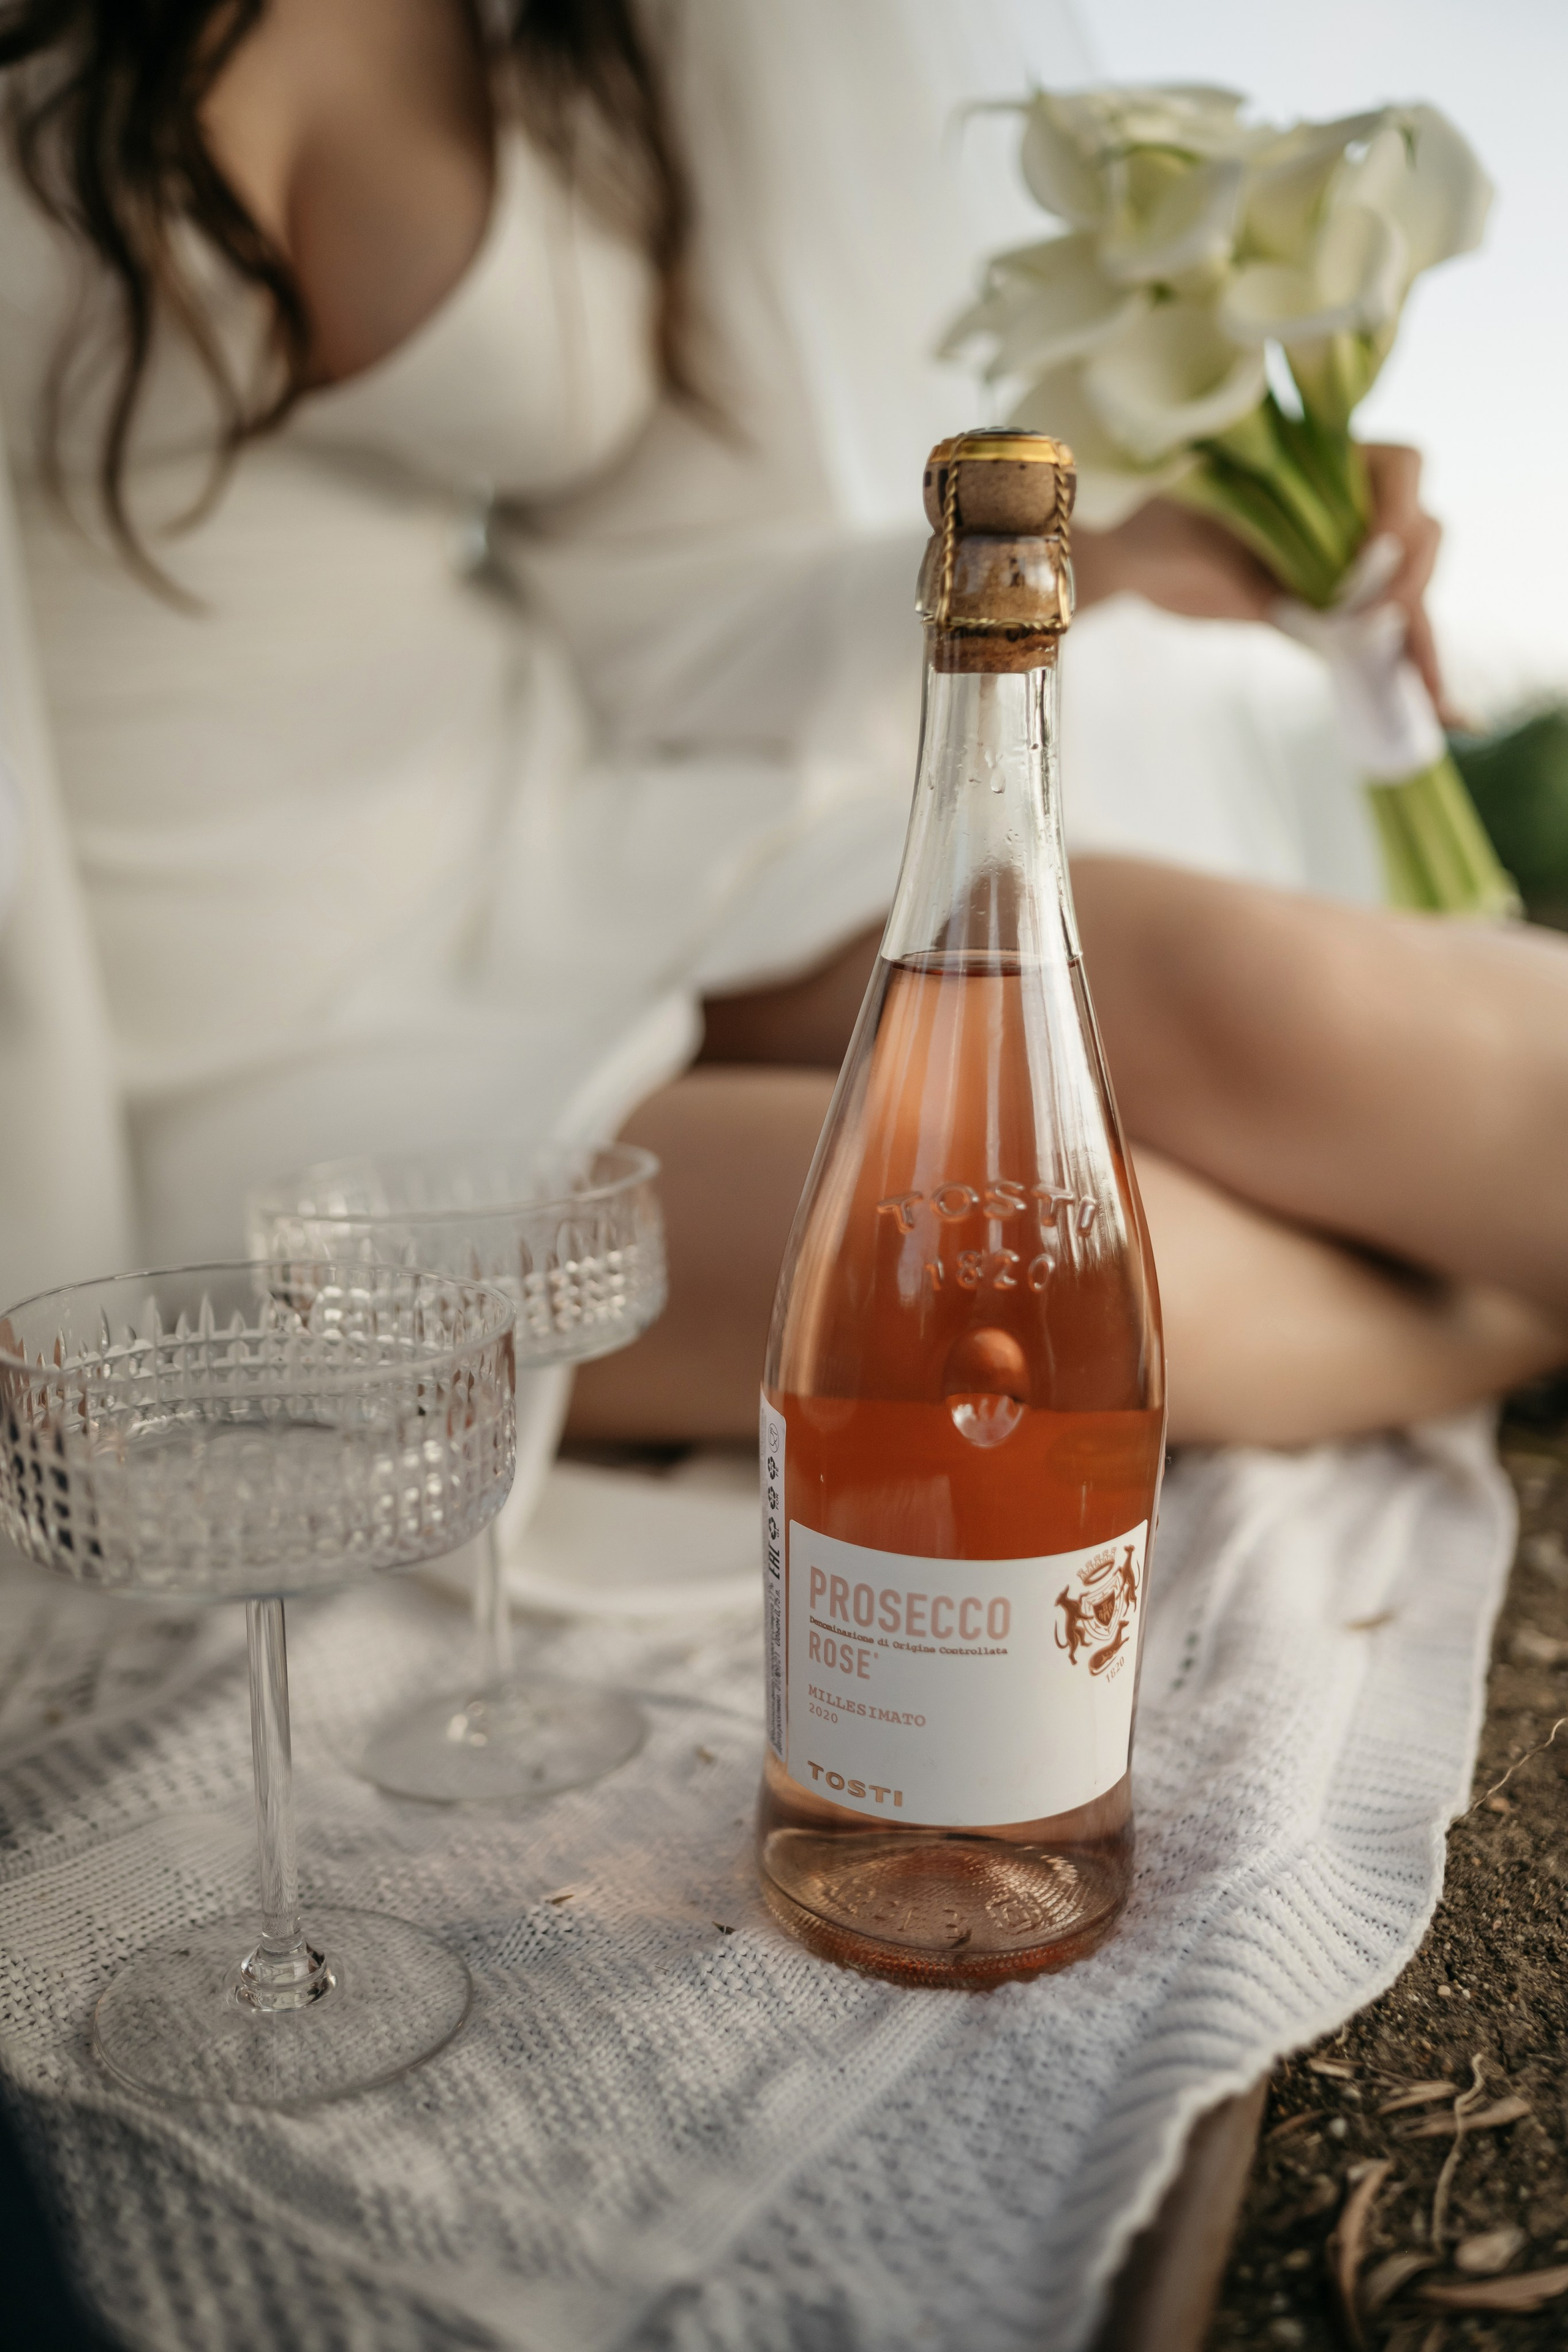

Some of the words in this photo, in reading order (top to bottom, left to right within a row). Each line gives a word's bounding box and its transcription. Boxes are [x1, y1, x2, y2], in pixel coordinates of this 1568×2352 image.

[877, 1180, 1097, 1237] TOSTI
[925, 1248, 1055, 1292] 1820
[810, 1566, 1011, 1640] PROSECCO
[809, 1615, 874, 1644] Denominazione
[878, 1638, 889, 1647] di
[892, 1642, 936, 1654] Origine
[939, 1646, 1008, 1655] Controllata
[1106, 1656, 1125, 1683] 1820
[809, 1684, 926, 1727] MILLESIMATO
[809, 1702, 838, 1724] 2020
[807, 1760, 903, 1807] TOSTI
